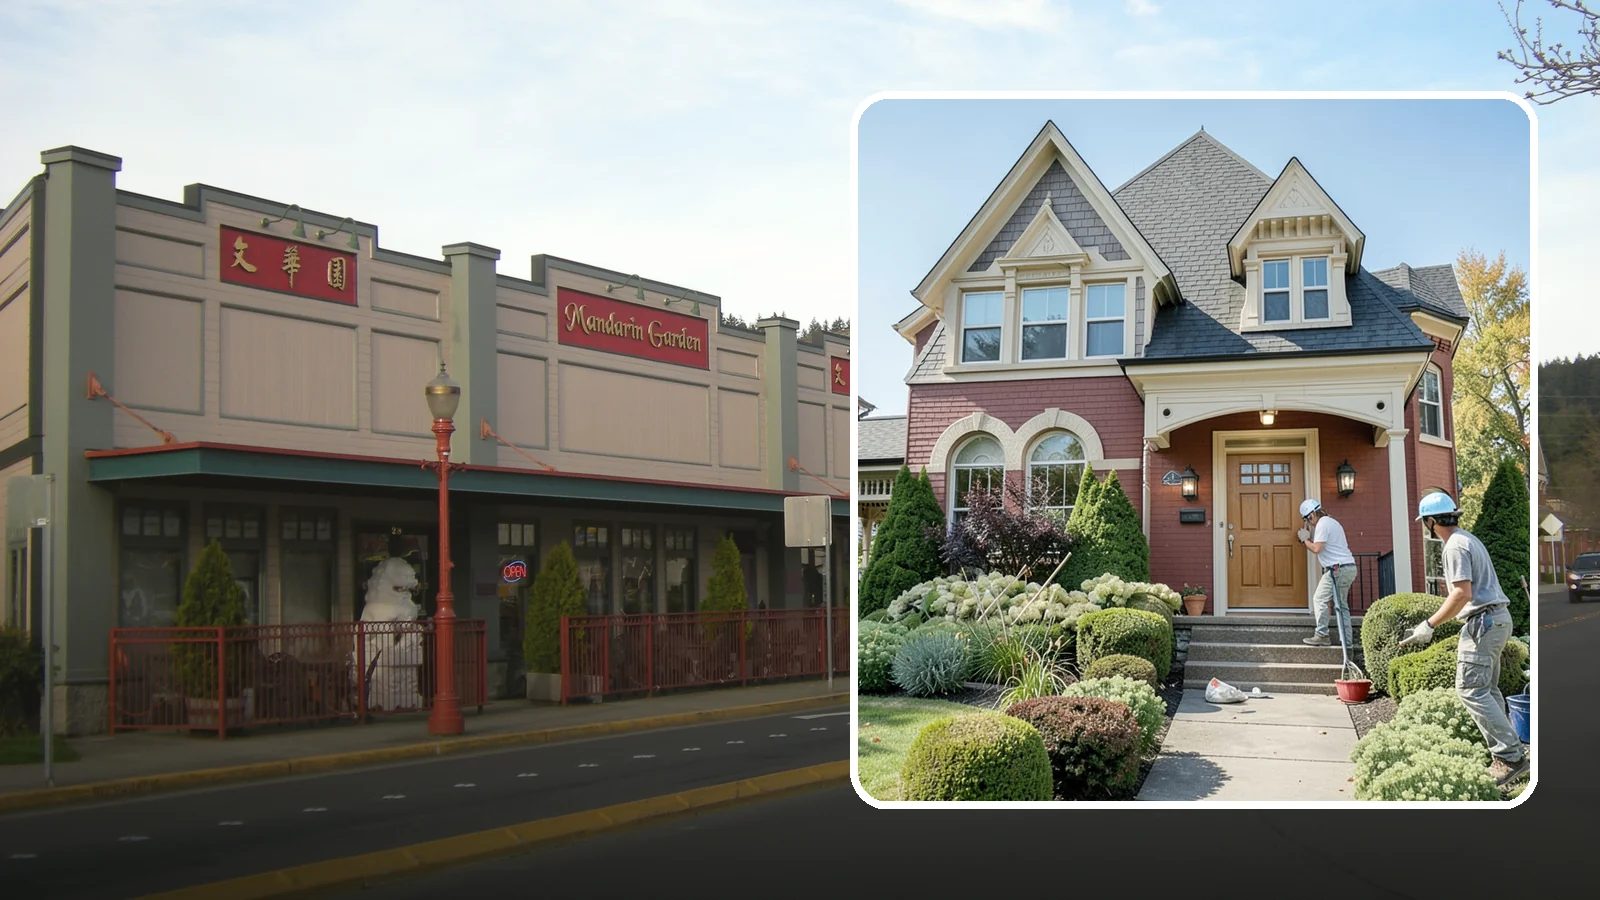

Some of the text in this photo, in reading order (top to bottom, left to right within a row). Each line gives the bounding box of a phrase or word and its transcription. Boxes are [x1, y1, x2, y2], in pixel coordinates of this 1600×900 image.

[231, 236, 346, 291] 文華園
[564, 302, 702, 353] Mandarin Garden
[503, 565, 527, 578] OPEN
